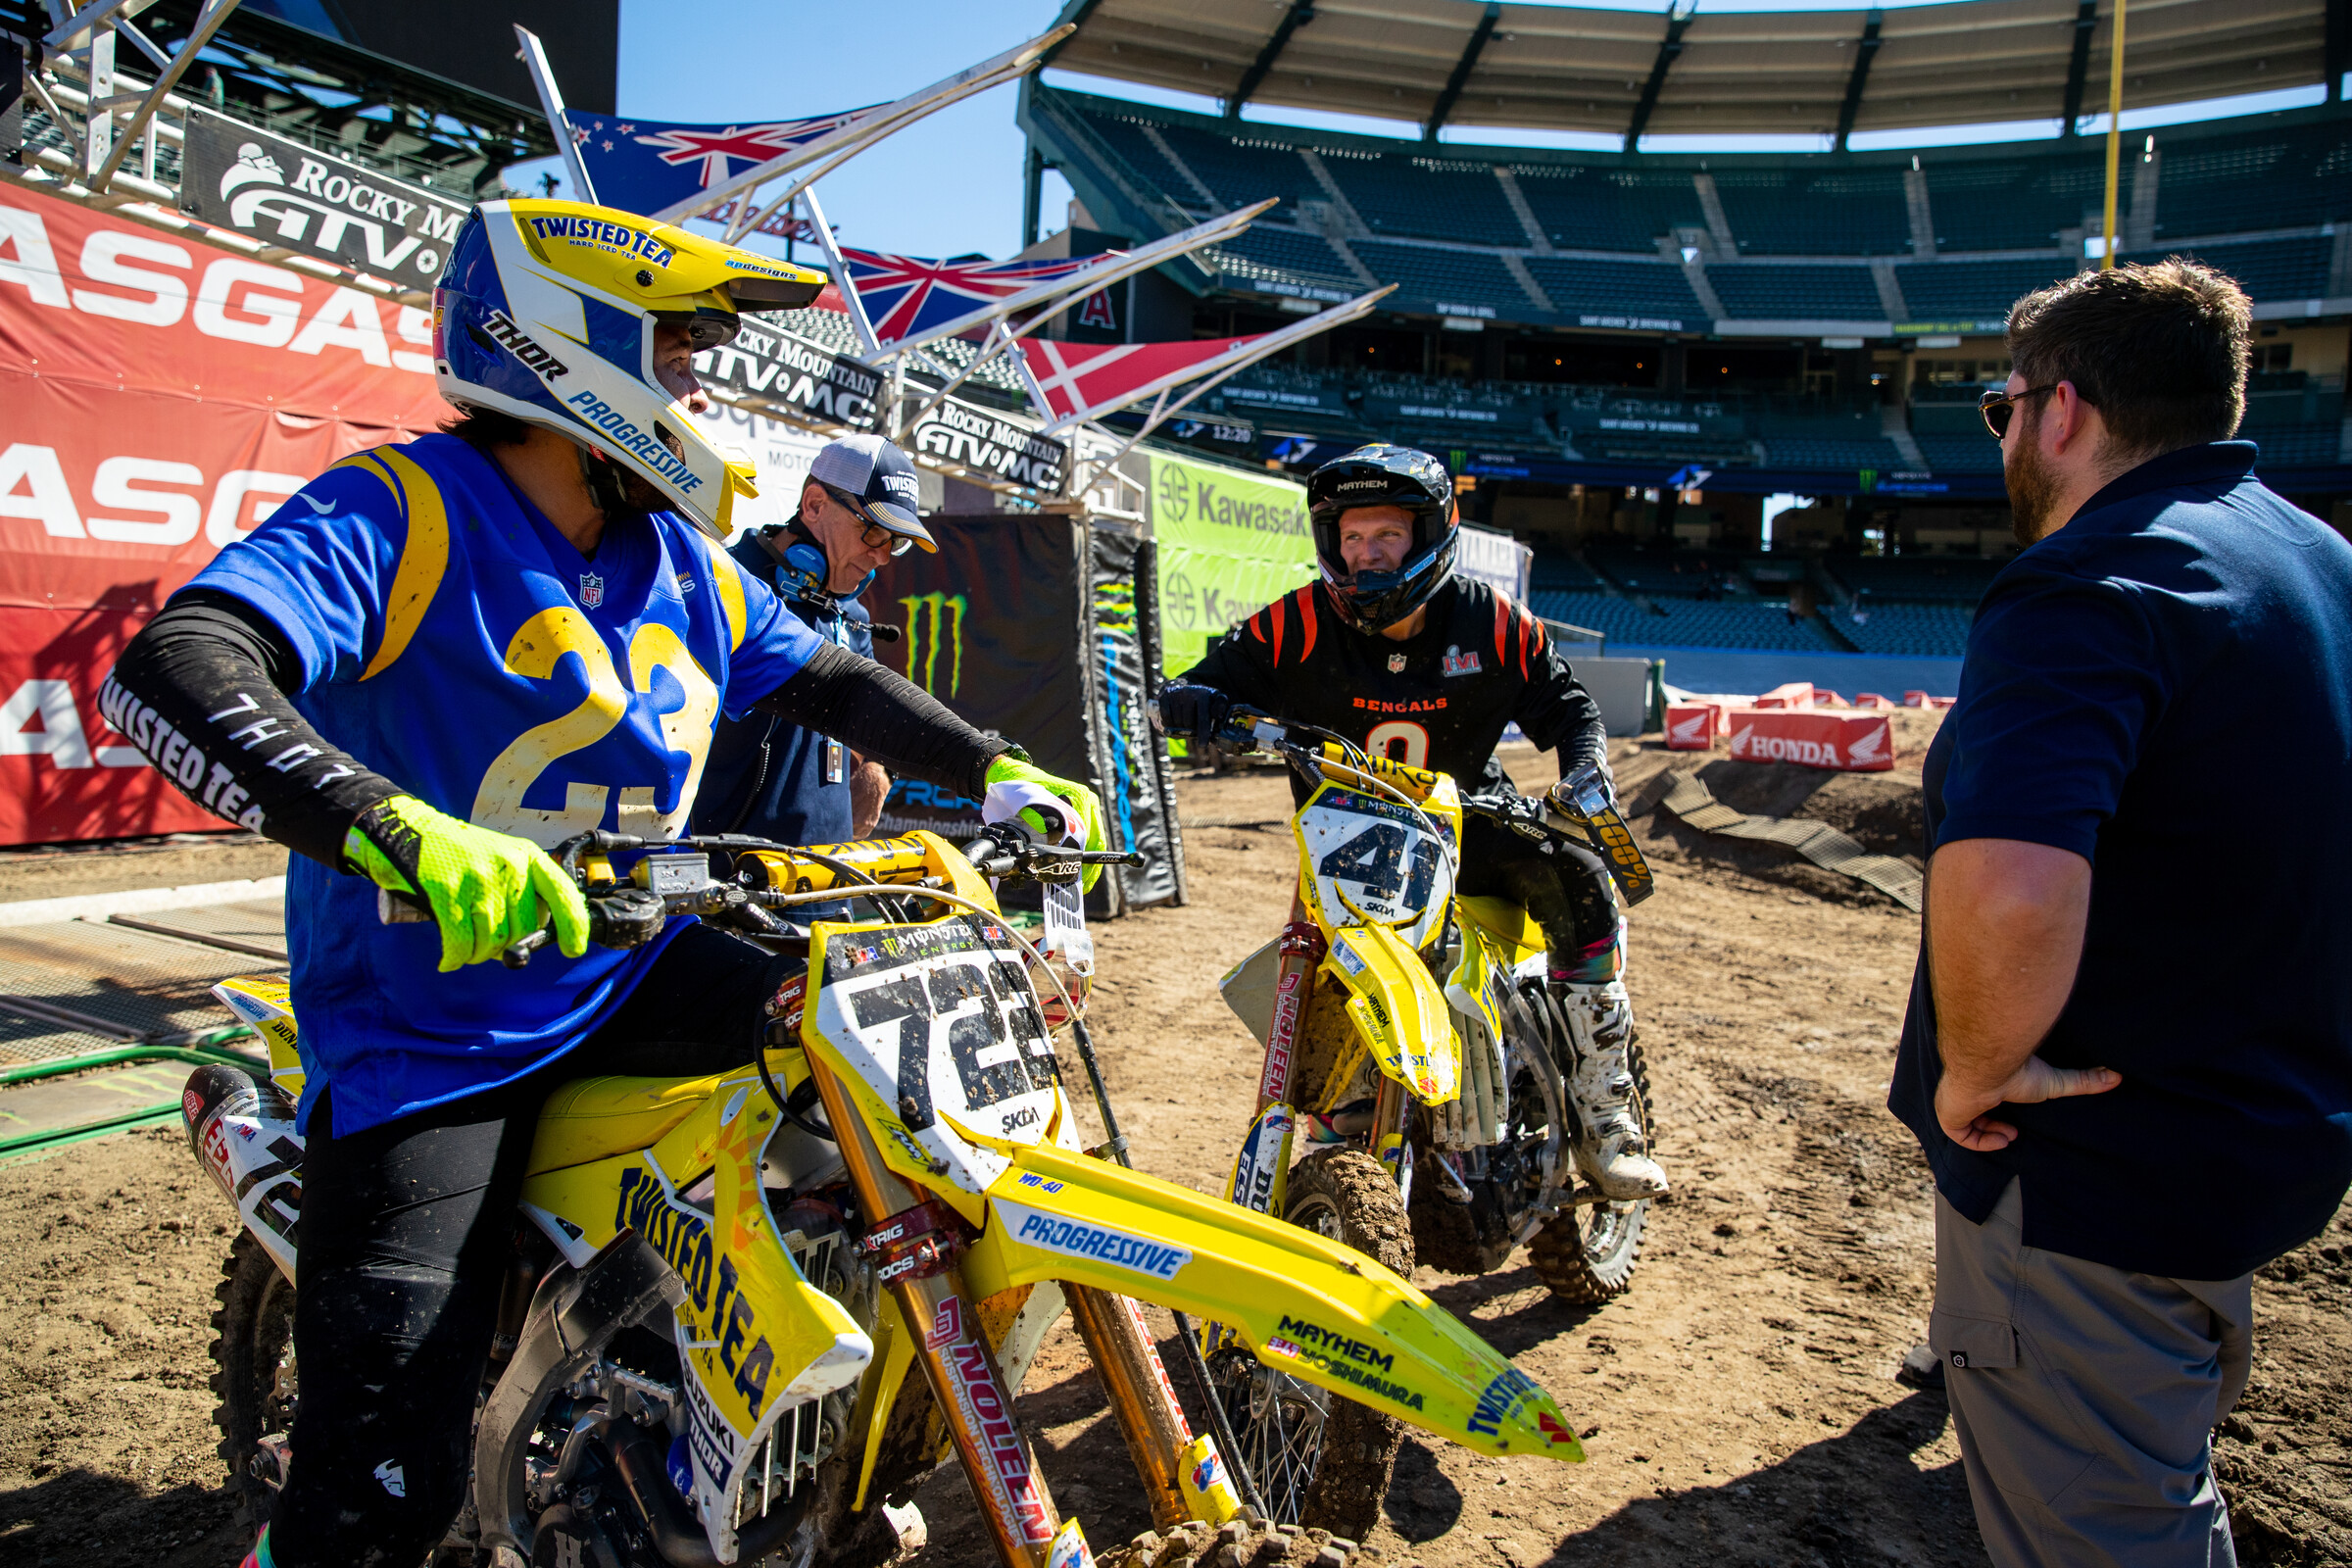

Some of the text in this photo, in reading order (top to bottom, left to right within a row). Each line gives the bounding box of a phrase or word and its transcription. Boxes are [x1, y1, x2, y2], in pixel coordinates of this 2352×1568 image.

[290, 157, 424, 227] ROCKY
[230, 188, 423, 270] ATV
[530, 217, 674, 270] TWISTED TEA
[568, 239, 637, 261] HARD ICED TEA
[725, 259, 799, 280] apdesigns
[484, 312, 568, 383] THOR
[774, 337, 878, 398] MOUNTAIN
[566, 389, 704, 495] PROGRESSIVE
[939, 402, 1063, 465] ROCKY MOUNTAIN
[1337, 480, 1389, 492] MAYHEM
[583, 588, 600, 604] NFL
[471, 607, 721, 852] 23
[1352, 697, 1448, 713] BENGALS
[207, 692, 358, 790] THOR
[1749, 736, 1842, 767] HONDA
[203, 761, 267, 835] TEA
[1096, 854, 1122, 863] ARC
[1513, 822, 1548, 841] ARC
[1591, 808, 1651, 889] 100%
[1039, 860, 1082, 876] ARC
[1318, 822, 1443, 913] 41
[1367, 993, 1391, 1028] MAYHEM
[1017, 1172, 1065, 1194] WD-40
[1018, 1214, 1184, 1276] PROGRESSIVE
[710, 1252, 775, 1422] TEA
[1278, 1314, 1395, 1373] MAYHEM
[683, 1357, 734, 1456] SUZUKI
[1298, 1347, 1424, 1411] YOSHIMURA
[689, 1417, 725, 1481] THOR
[938, 1347, 1025, 1549] SUSPENSION TECHNOLOGIES
[950, 1339, 1055, 1544] NOLEEN
